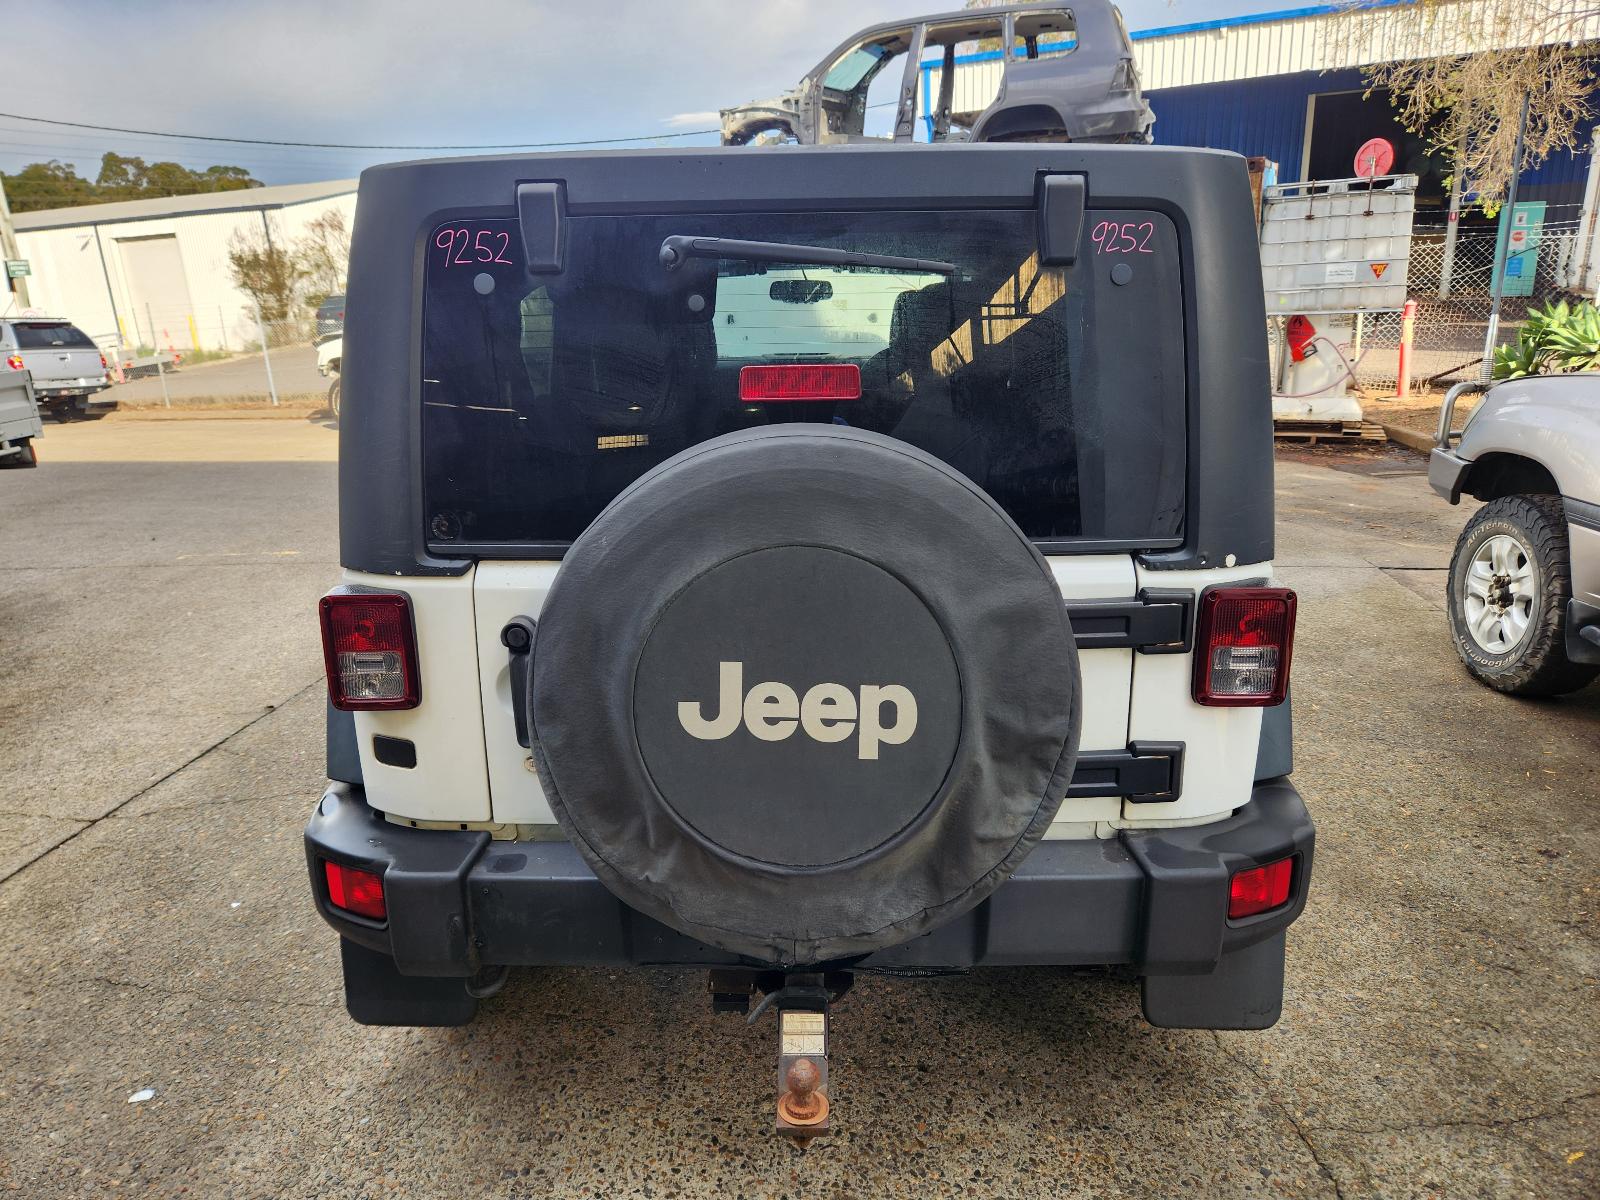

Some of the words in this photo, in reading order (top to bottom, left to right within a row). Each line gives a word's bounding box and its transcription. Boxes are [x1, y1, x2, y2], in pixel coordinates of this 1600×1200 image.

[436, 229, 513, 267] 9252
[1091, 221, 1154, 255] 9252
[677, 661, 918, 760] Jeep
